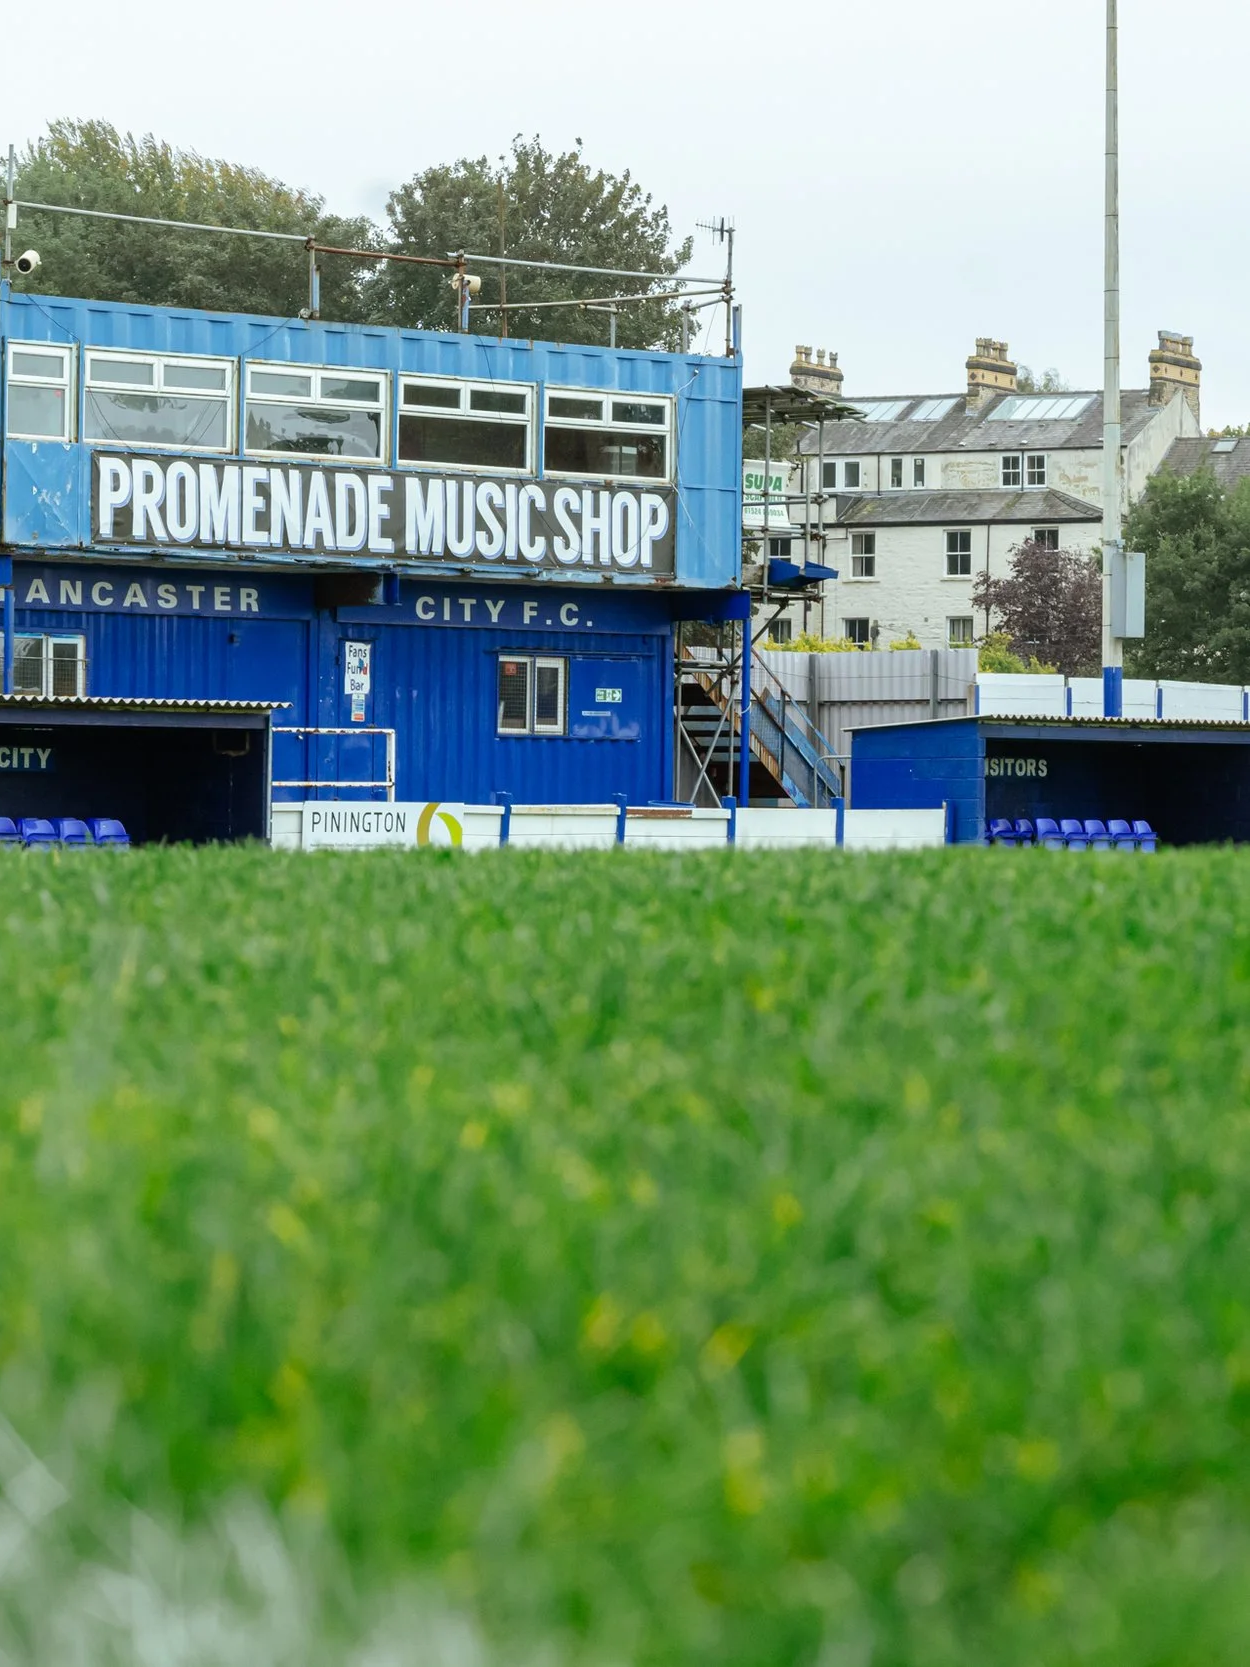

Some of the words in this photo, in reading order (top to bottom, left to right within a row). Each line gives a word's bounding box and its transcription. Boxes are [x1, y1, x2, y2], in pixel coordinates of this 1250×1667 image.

[99, 456, 395, 553] PROMENADE
[404, 476, 547, 562] MUSIC
[552, 484, 670, 568] SHOP
[415, 596, 506, 623] CITY
[523, 601, 593, 627] F.C.
[348, 645, 367, 658] Fans
[347, 661, 369, 675] Fund
[350, 679, 365, 691] Bar
[985, 757, 1048, 777] ISITORS
[311, 811, 407, 833] PININGTON
